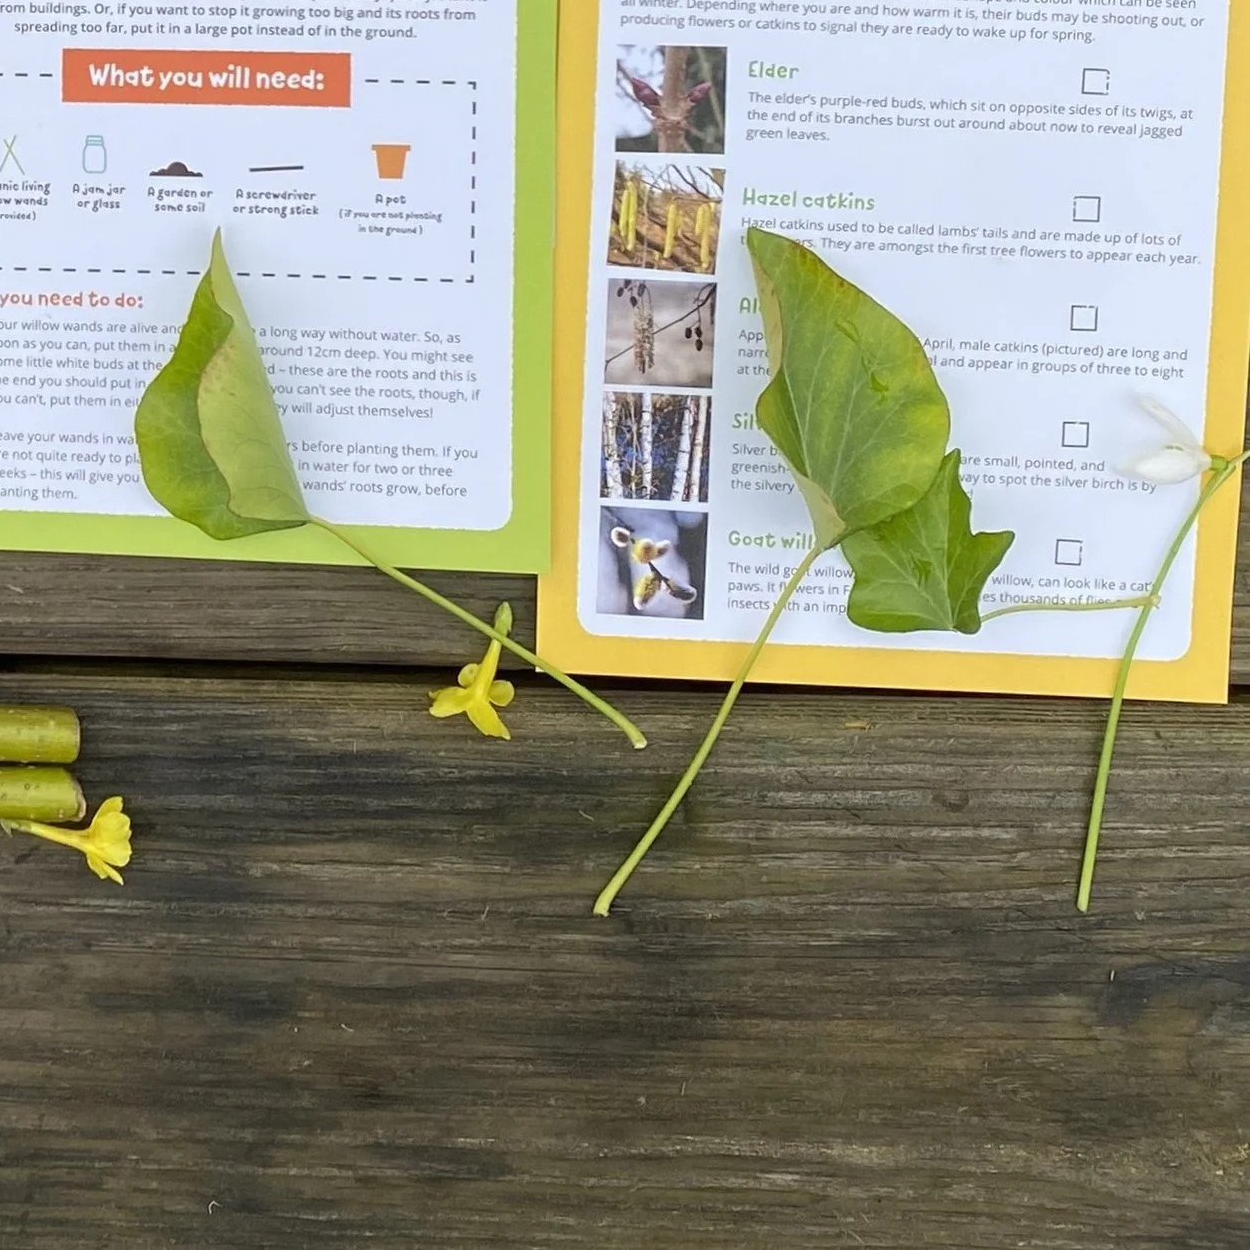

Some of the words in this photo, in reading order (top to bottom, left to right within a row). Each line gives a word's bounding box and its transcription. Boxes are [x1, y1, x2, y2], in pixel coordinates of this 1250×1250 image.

[748, 60, 799, 78] Elder
[89, 63, 154, 86] What
[159, 71, 202, 90] you
[208, 64, 249, 88] will
[256, 69, 323, 89] need:
[748, 91, 771, 103] The
[774, 92, 816, 105] elder's
[820, 95, 887, 109] purple-red
[891, 97, 925, 110] buds,
[929, 98, 966, 110] which
[970, 102, 985, 111] sit
[989, 103, 1005, 112] on
[1009, 104, 1065, 116] opposite
[1068, 104, 1101, 115] sides
[1105, 105, 1118, 116] of
[1122, 105, 1136, 117] its
[1140, 107, 1175, 121] twigs,
[1180, 109, 1192, 119] at
[745, 128, 782, 140] green
[787, 128, 829, 140] leaves.
[21, 180, 50, 195] living
[72, 183, 79, 193] A
[82, 183, 104, 195] jam
[106, 183, 125, 196] jar
[147, 186, 154, 196] A
[156, 188, 196, 200] garden
[236, 188, 243, 198] A
[246, 189, 316, 200] screwdriver
[14, 195, 47, 205] wands
[92, 198, 120, 212] glass
[375, 193, 382, 203] A
[386, 195, 406, 206] pot
[742, 187, 796, 207] Hazel
[802, 192, 874, 210] catkins
[154, 200, 183, 211] some
[186, 202, 205, 212] soil
[248, 205, 287, 218] strong
[289, 204, 318, 214] stick
[0, 294, 32, 307] you
[38, 291, 82, 306] need
[88, 291, 109, 307] to
[114, 292, 143, 308] do:
[258, 327, 266, 338] a
[270, 325, 297, 341] long
[300, 329, 325, 341] way
[329, 328, 377, 340] without
[380, 331, 419, 341] water.
[424, 331, 442, 344] So,
[446, 334, 460, 343] as
[42, 486, 77, 499] them.
[727, 530, 776, 549] Goat
[780, 531, 816, 550] will
